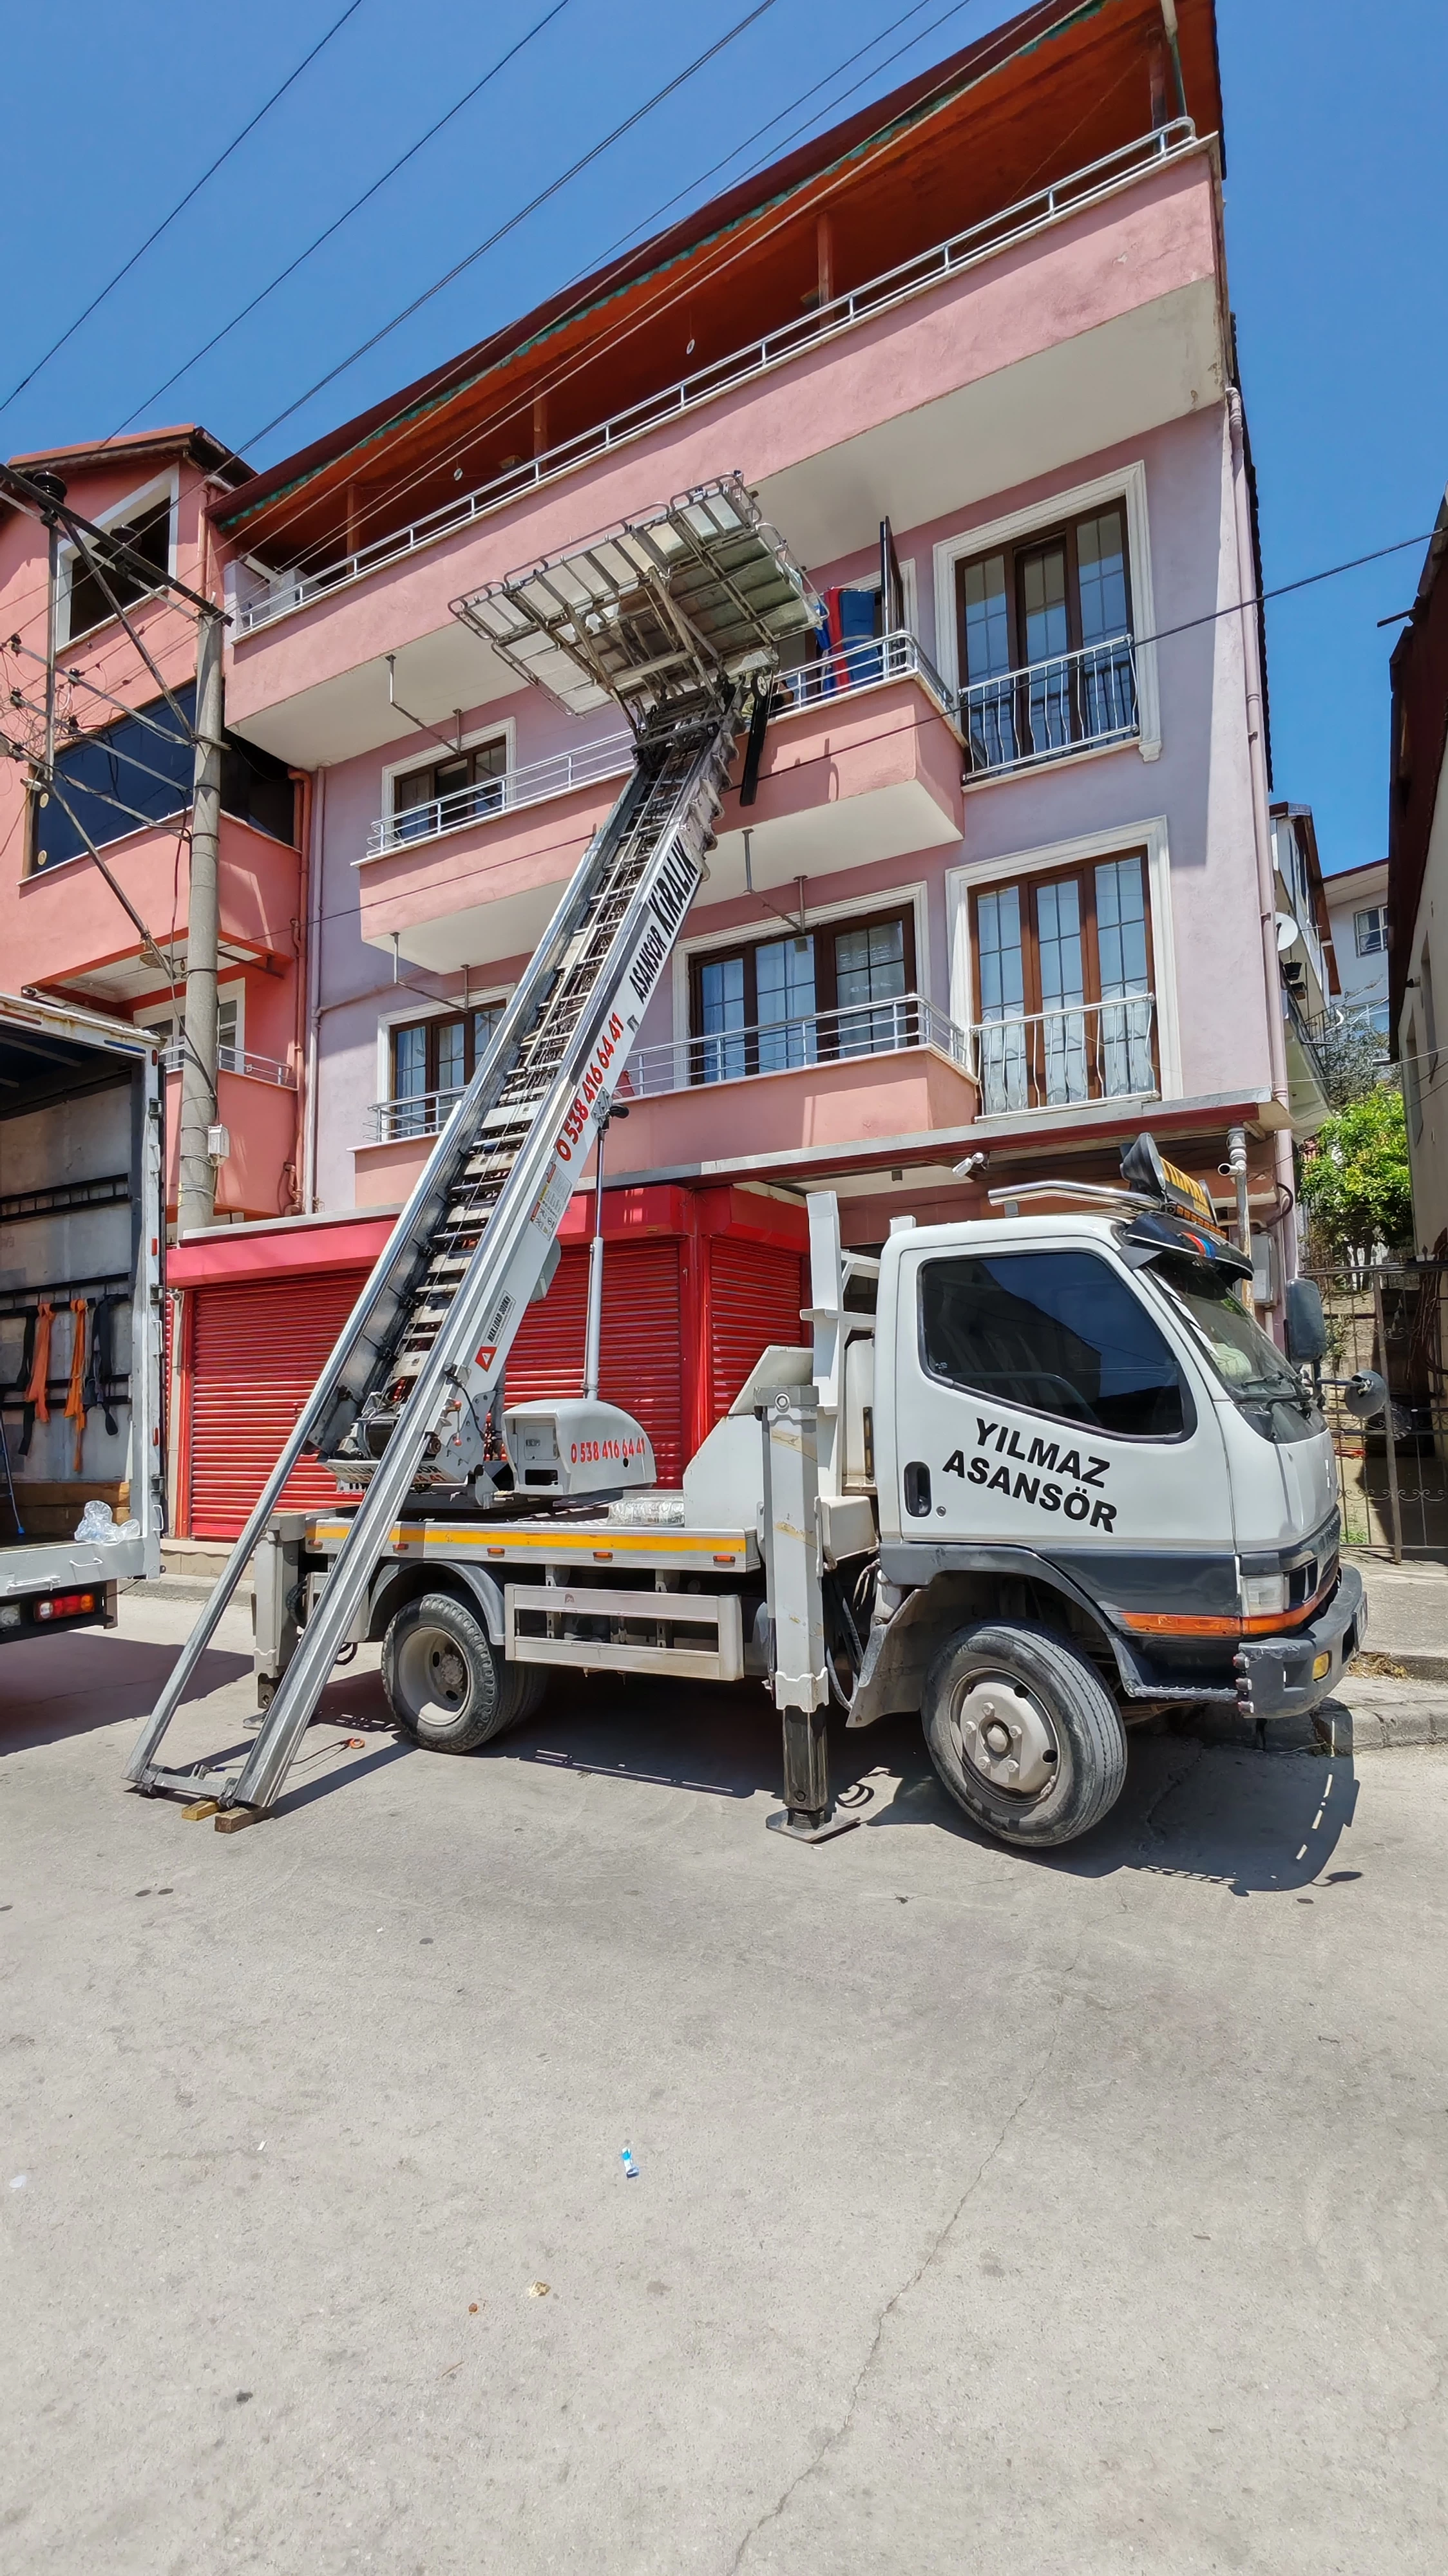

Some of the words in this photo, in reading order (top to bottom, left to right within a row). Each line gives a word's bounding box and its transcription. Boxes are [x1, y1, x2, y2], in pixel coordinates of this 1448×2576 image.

[556, 1139, 571, 1161] 0
[564, 1097, 589, 1145] 538
[582, 1065, 604, 1104] 416
[596, 1035, 614, 1070] 64
[609, 1012, 624, 1042] 41
[571, 1443, 578, 1464] 0
[580, 1441, 600, 1463] 538
[602, 1439, 620, 1459] 416
[622, 1439, 634, 1459] 64
[636, 1437, 645, 1455] 41
[976, 1417, 1110, 1488] YILMAZ
[942, 1450, 1118, 1533] ASANSÖR
